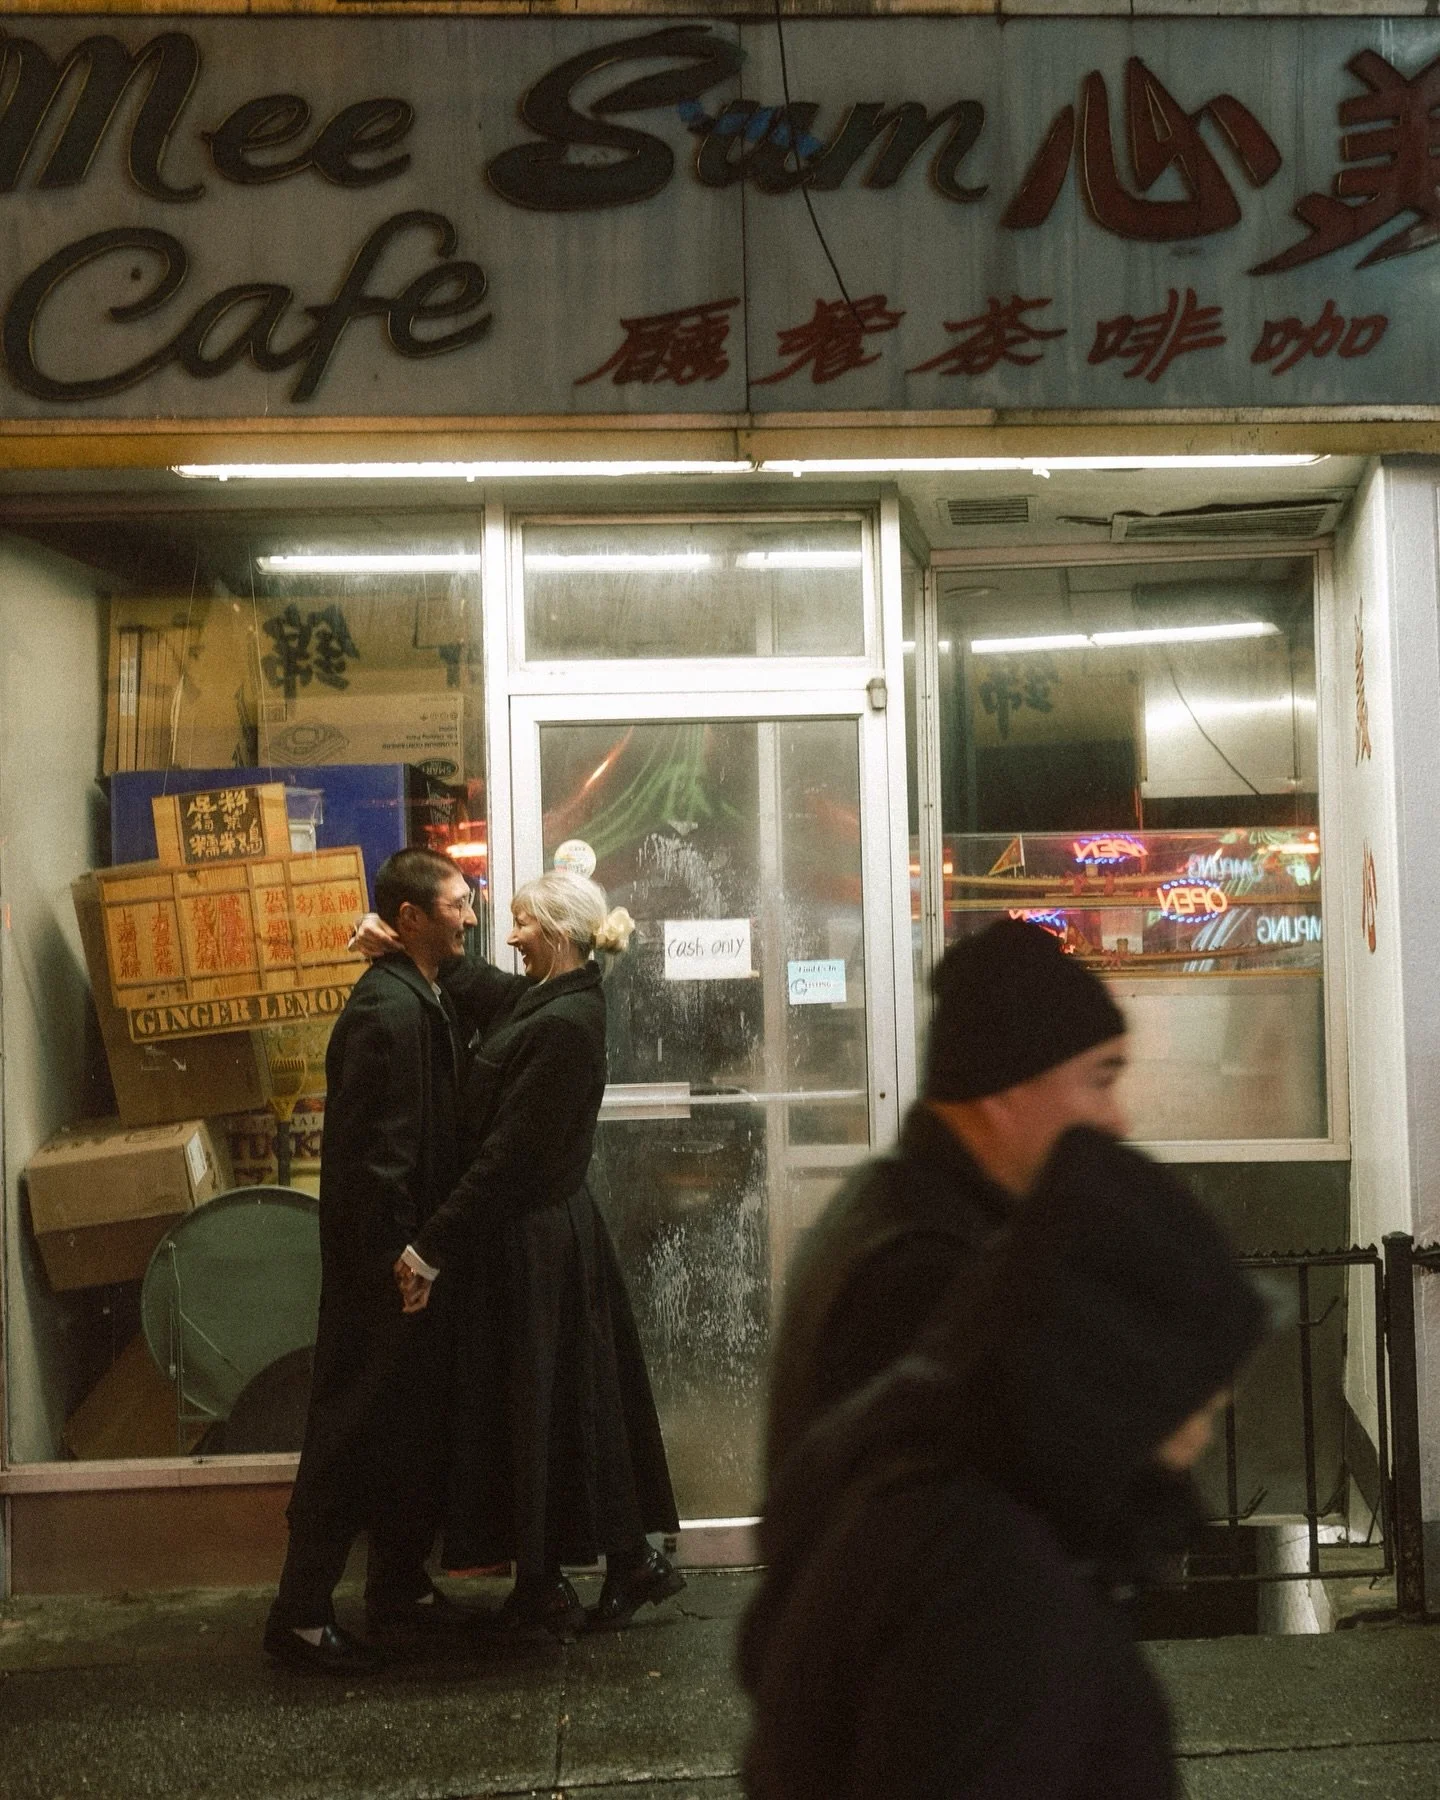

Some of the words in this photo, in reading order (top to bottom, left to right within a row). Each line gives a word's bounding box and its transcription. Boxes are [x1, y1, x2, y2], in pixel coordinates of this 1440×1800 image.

[0, 30, 414, 200] Mee
[486, 24, 990, 211] Sum
[0, 209, 493, 402] Cafe
[711, 938, 745, 958] only
[136, 997, 252, 1034] GINGER
